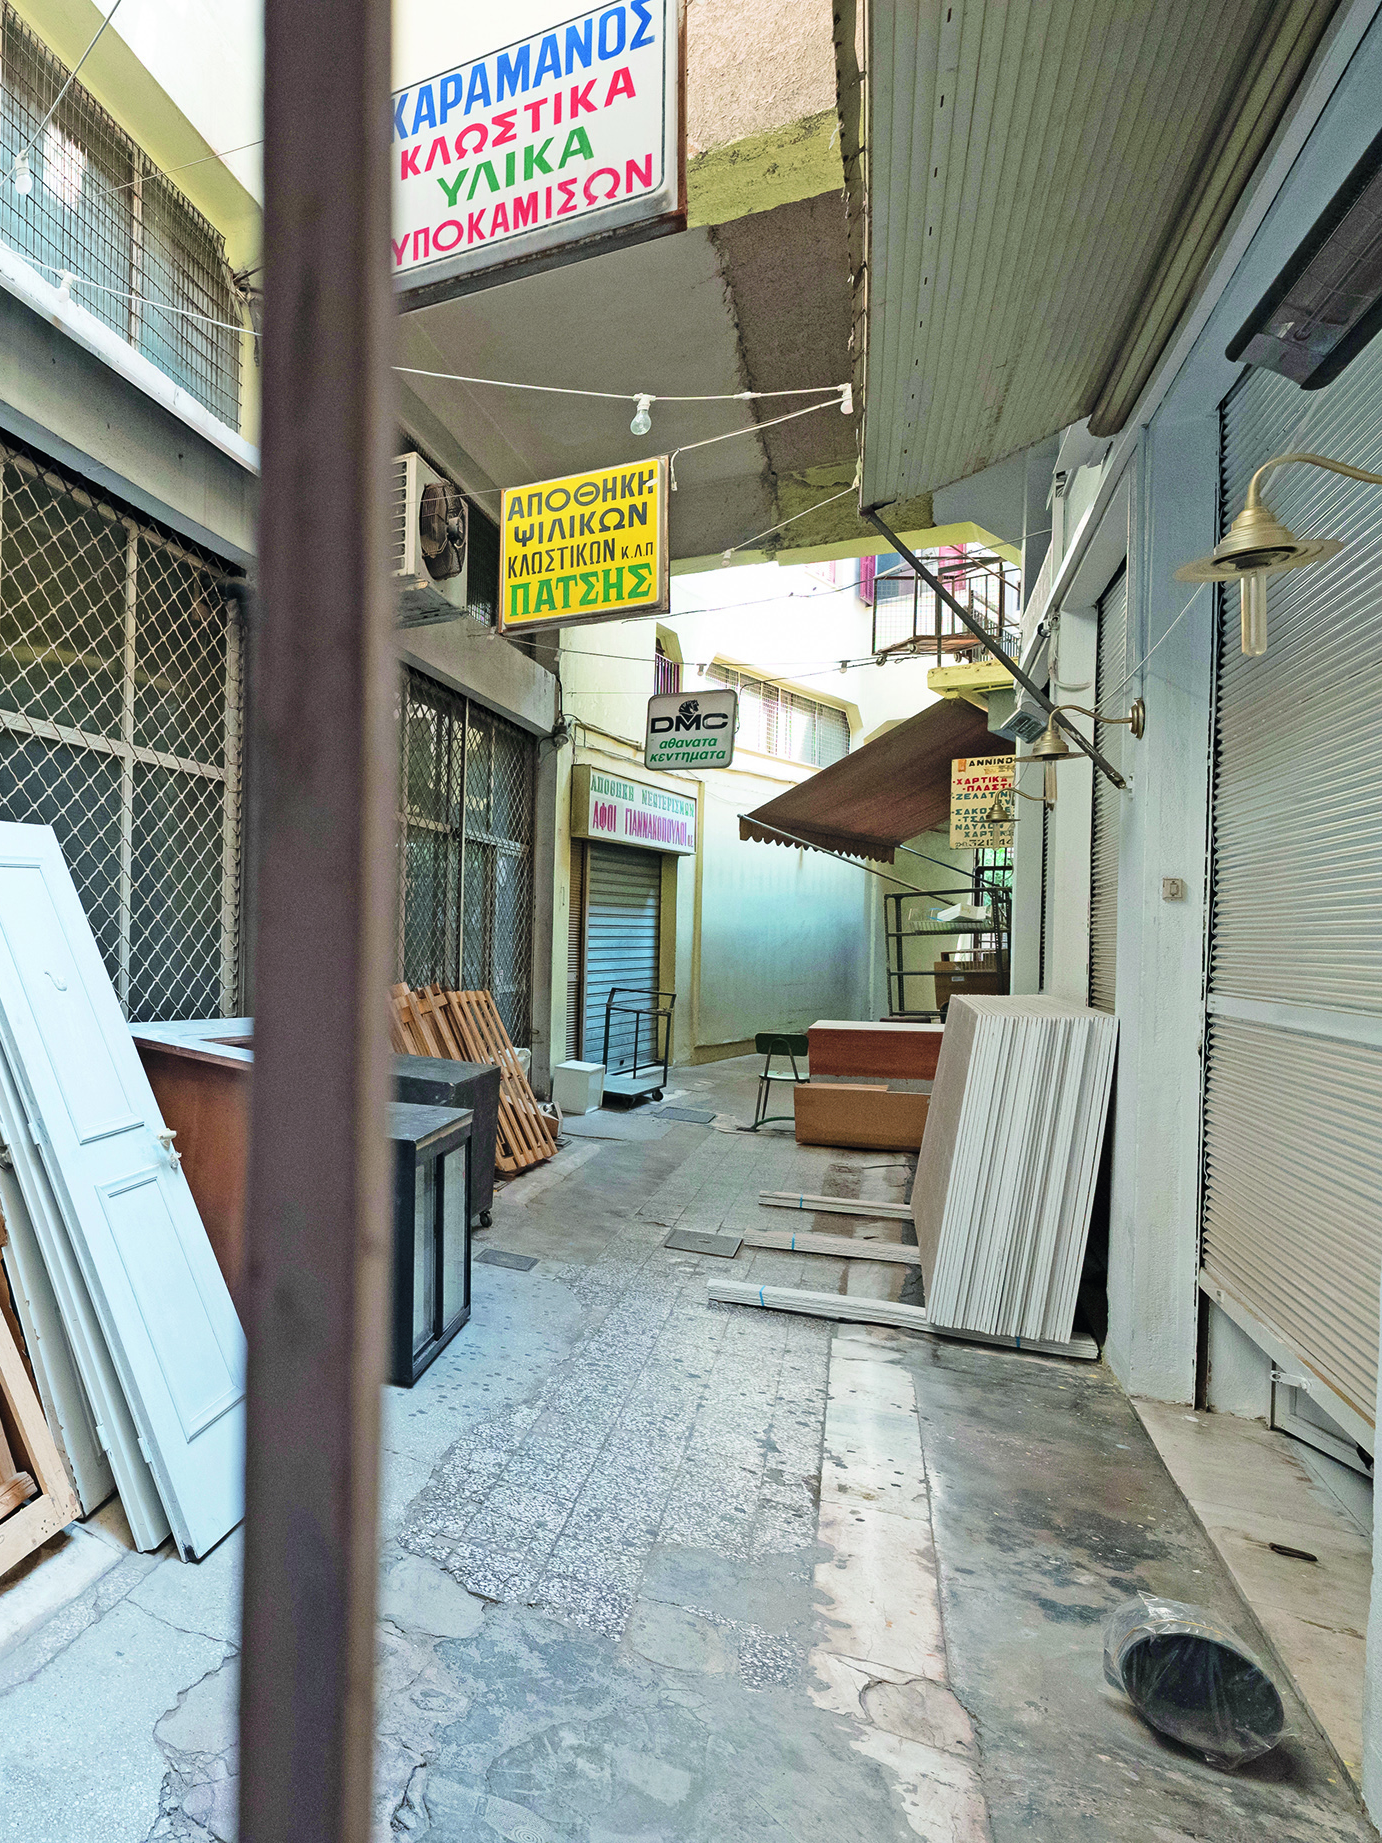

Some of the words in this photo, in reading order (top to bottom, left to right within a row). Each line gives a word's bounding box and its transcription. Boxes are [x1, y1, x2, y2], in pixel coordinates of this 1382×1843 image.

[401, 66, 636, 181] ΚΛΩΣΤΙΚΑ
[436, 125, 595, 208] ΥΛΙΚΑ
[392, 153, 653, 266] ΥΠΟΚΑΜΙΣΩΝ
[507, 469, 654, 521] ΑΠΟΘΗΚΗ
[514, 501, 648, 547] ΨΙΛΙΚΩΝ
[508, 538, 615, 579] ΚΛΩΣΤΙΚΩΝ
[509, 562, 653, 617] ΠΑΤΣΗΣ
[650, 713, 729, 734] DMC
[659, 737, 718, 749] αθανατα
[649, 749, 726, 763] κεντηματα
[590, 775, 635, 801] ΑΠΟΘΗΚΗ
